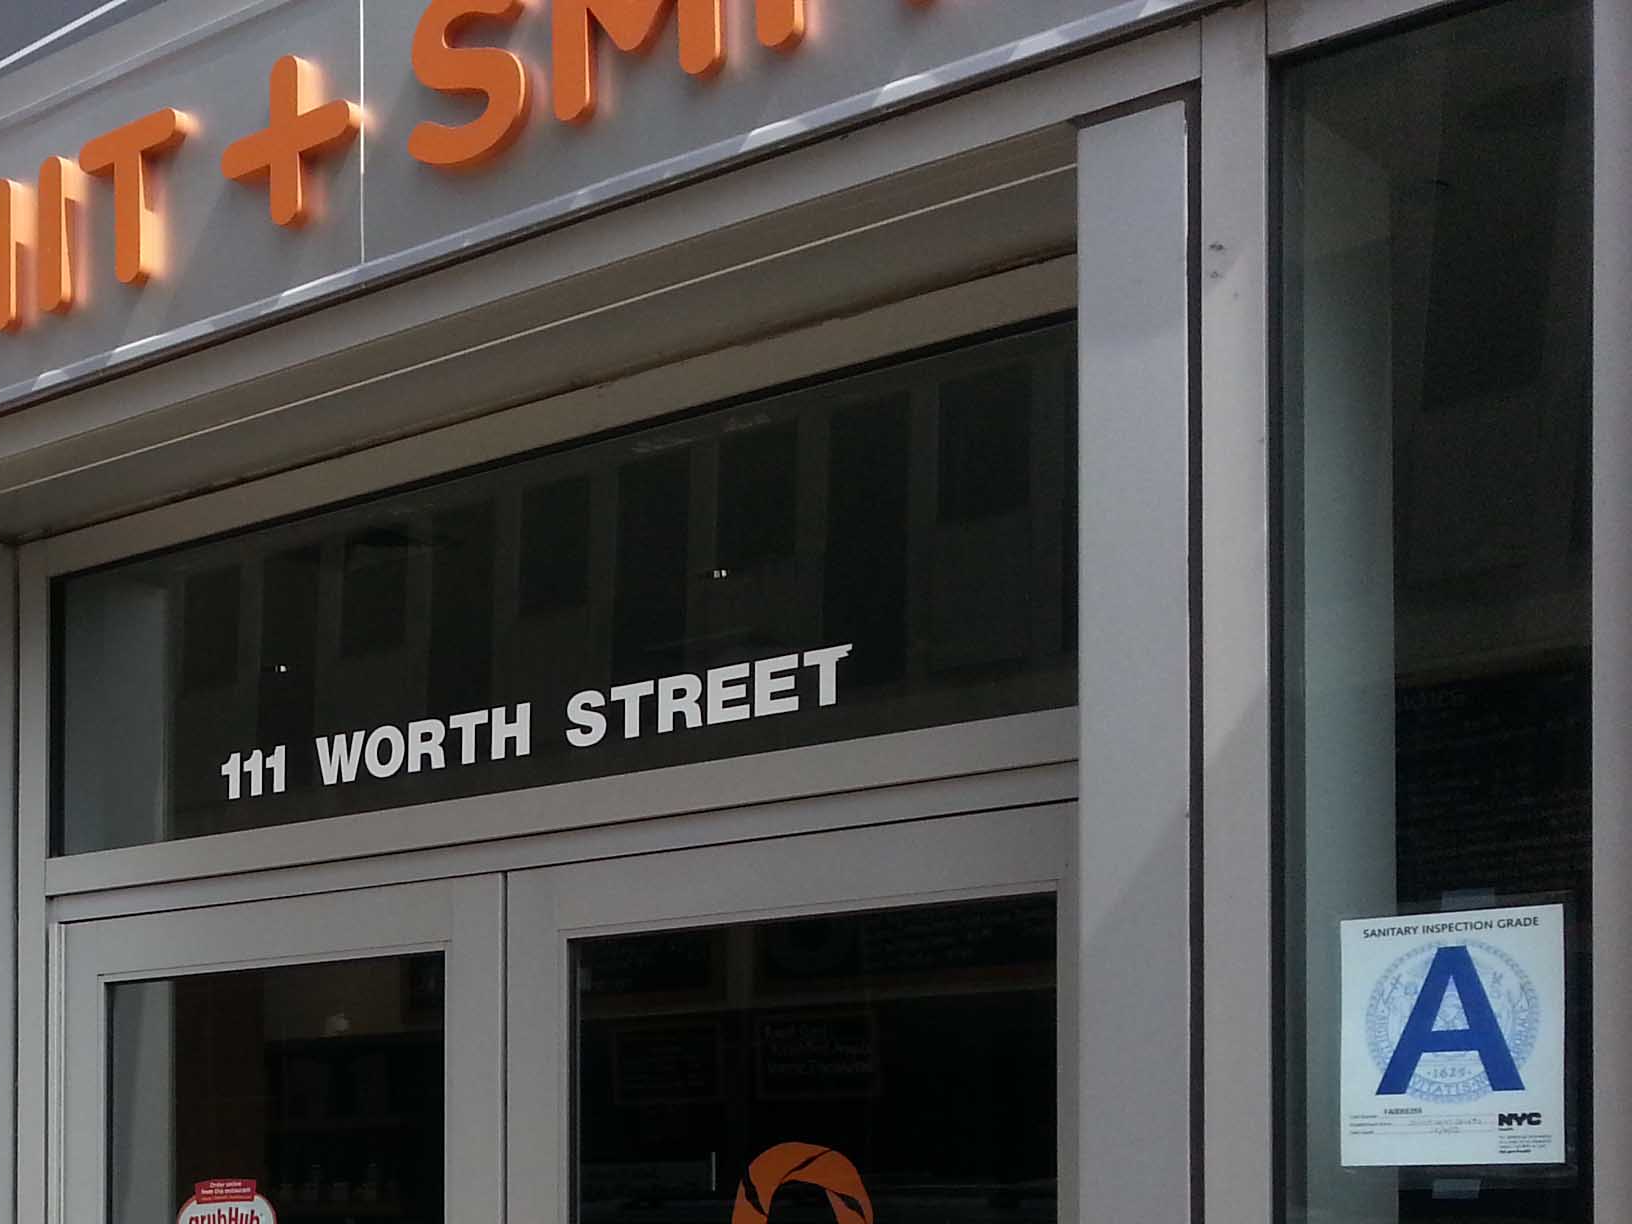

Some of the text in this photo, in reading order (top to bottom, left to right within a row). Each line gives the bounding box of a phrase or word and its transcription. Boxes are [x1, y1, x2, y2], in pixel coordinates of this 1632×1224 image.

[221, 644, 853, 799] 111 WORTH STREET
[1363, 916, 1539, 939] SANITARY INSPECTION GRADE
[1376, 945, 1525, 1095] A
[1498, 1112, 1542, 1127] NYC
